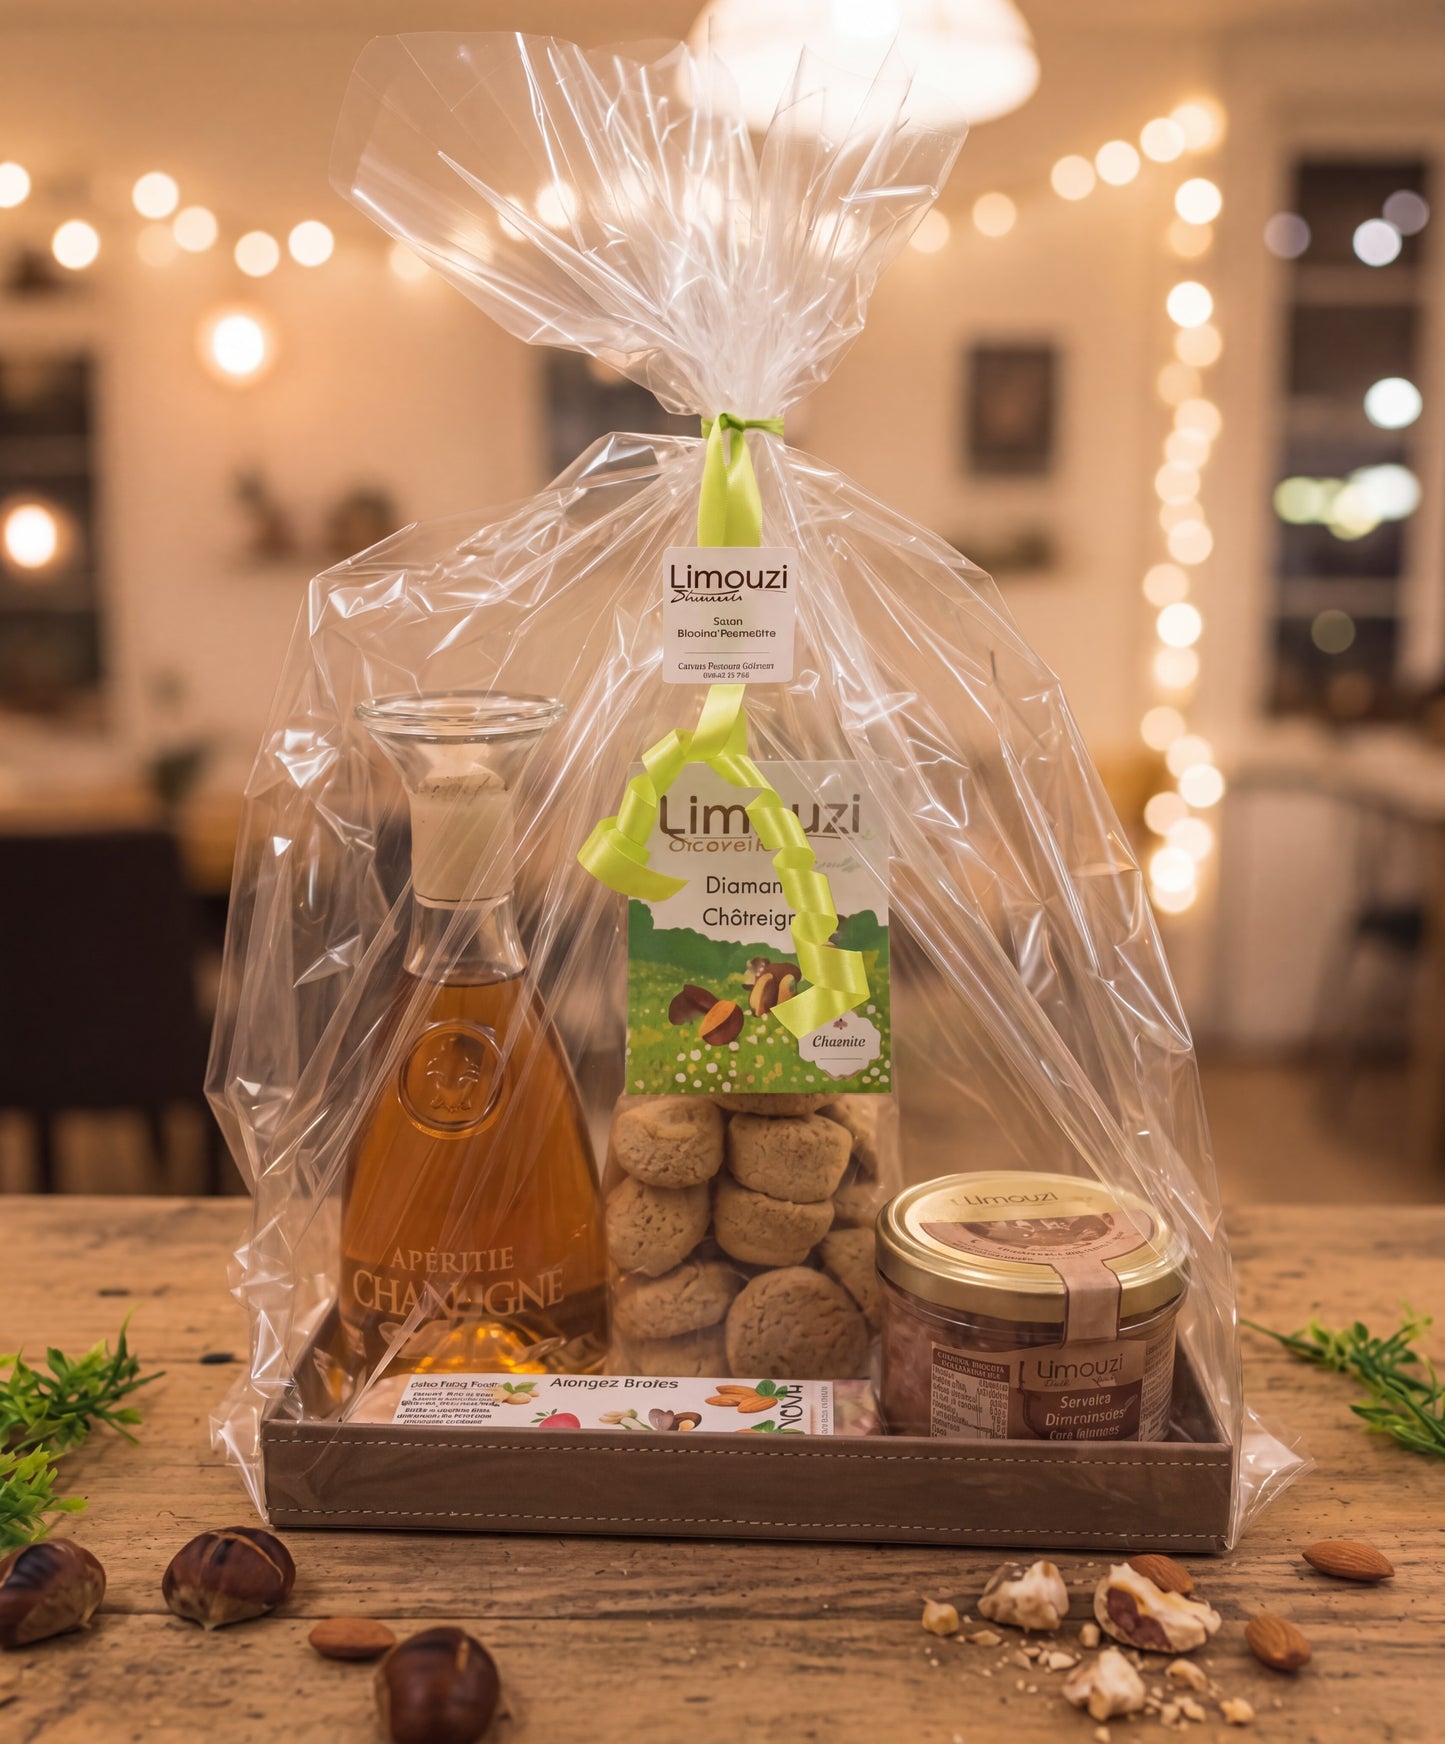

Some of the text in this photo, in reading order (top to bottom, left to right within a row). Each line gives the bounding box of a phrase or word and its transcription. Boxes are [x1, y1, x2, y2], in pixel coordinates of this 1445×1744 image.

[670, 564, 788, 589] Limouzi
[659, 793, 860, 835] Limuzi
[706, 875, 783, 895] Diaman
